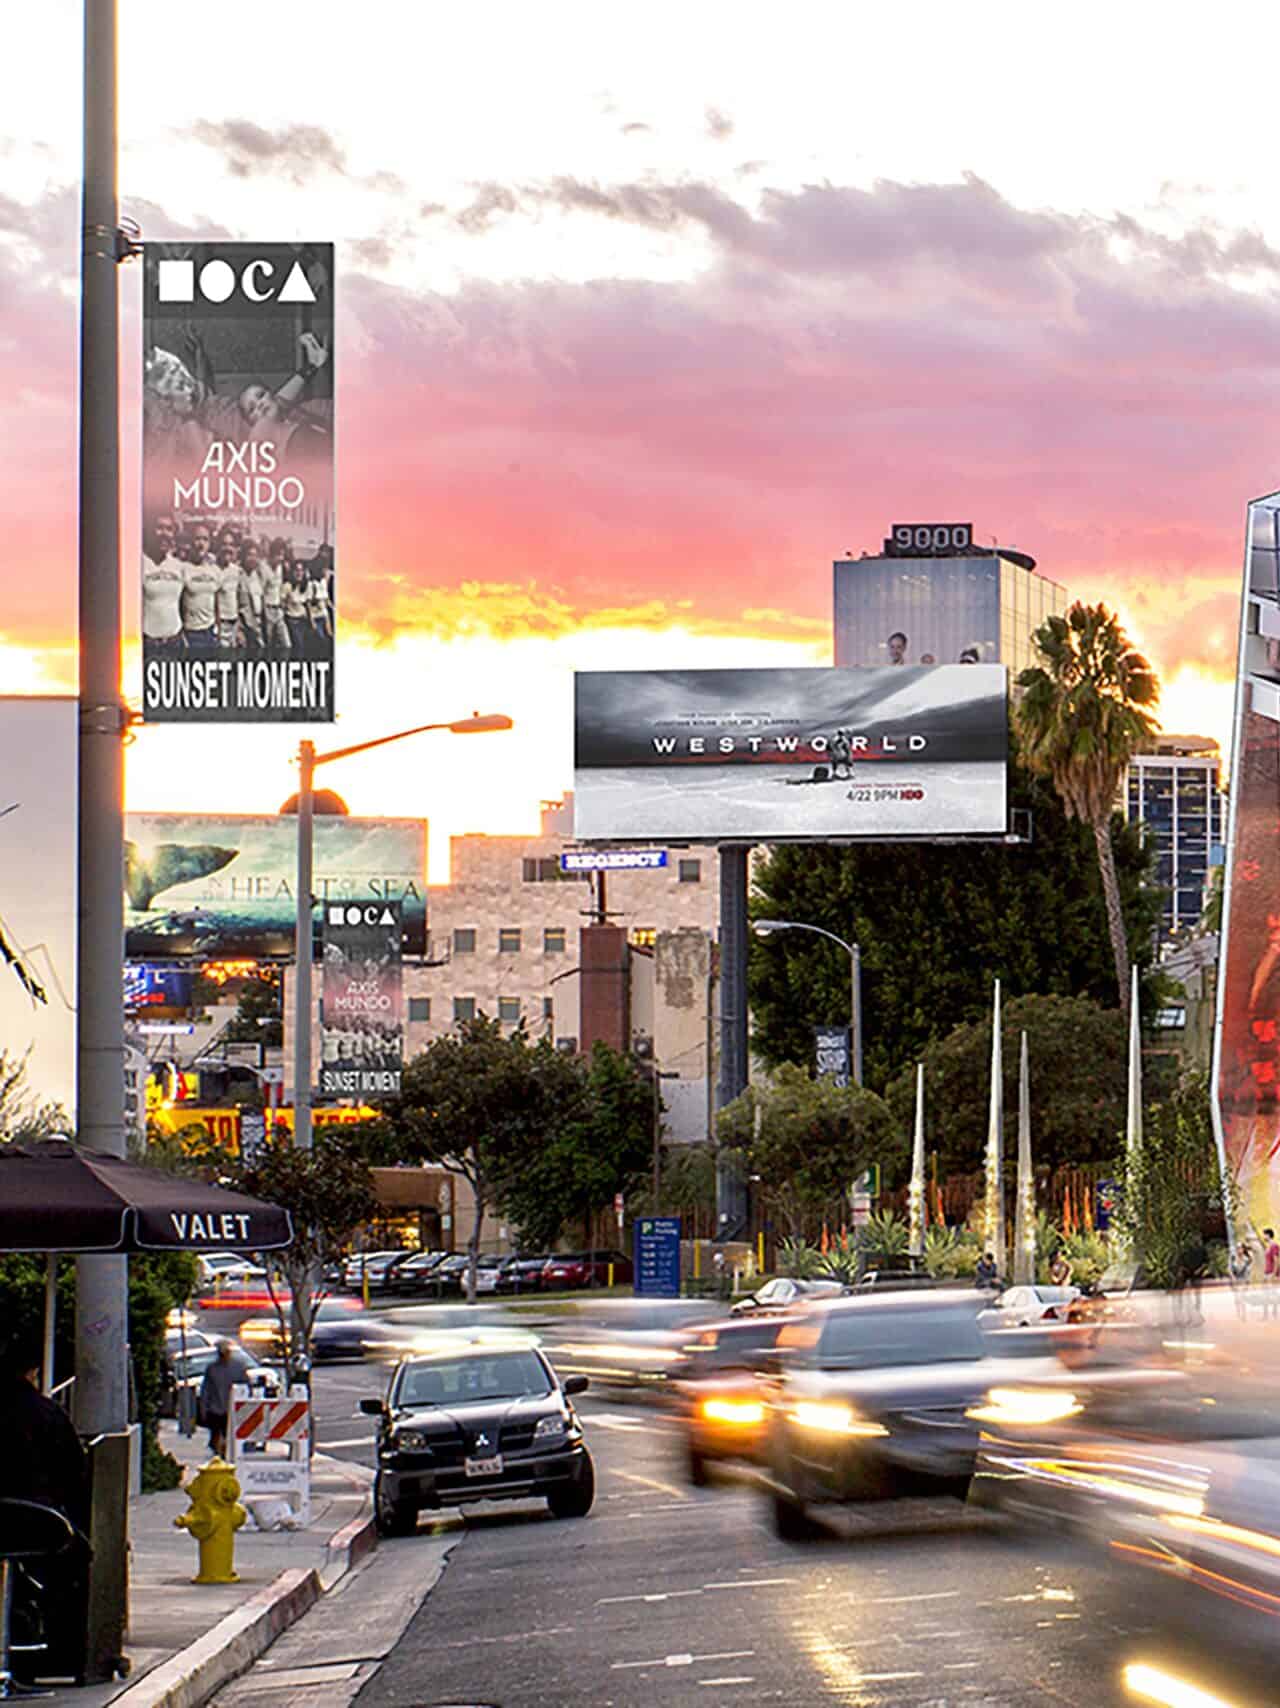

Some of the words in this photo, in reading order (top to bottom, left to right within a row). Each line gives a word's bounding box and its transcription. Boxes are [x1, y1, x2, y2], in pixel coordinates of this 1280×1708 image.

[201, 441, 277, 473] AXIS
[173, 476, 305, 509] MUNDO
[895, 526, 969, 550] 9000
[146, 660, 232, 709] SUNSET
[237, 660, 330, 709] MOMENT
[653, 735, 927, 753] WESTWORLD
[846, 789, 872, 802] 4/22
[231, 876, 338, 900] HEAT
[367, 877, 420, 901] SEA
[323, 1071, 360, 1092] SUNSET
[170, 1212, 250, 1241] VALET
